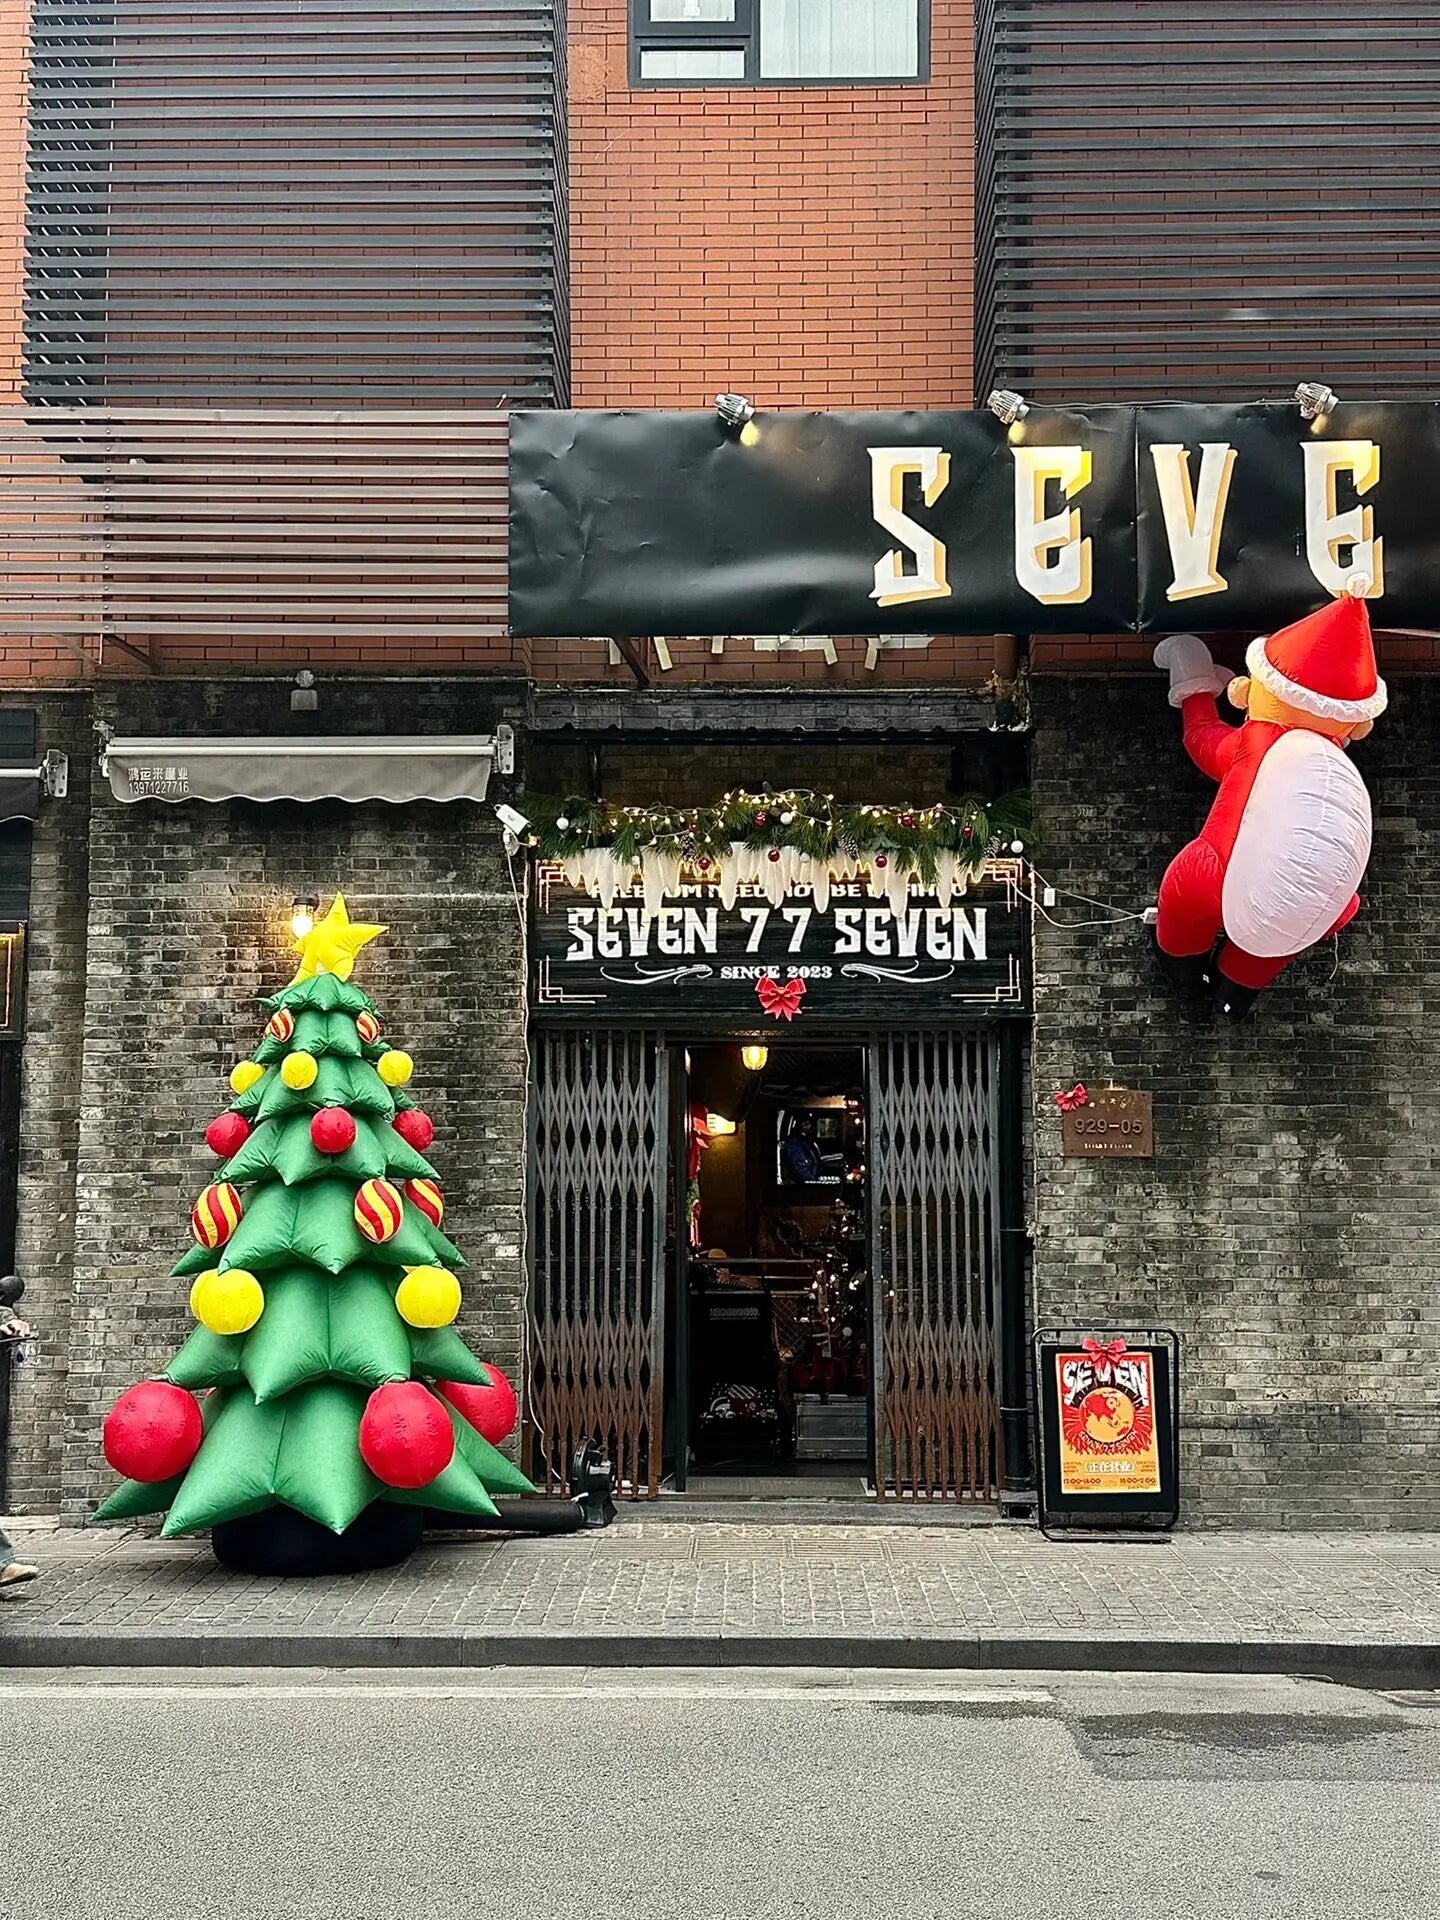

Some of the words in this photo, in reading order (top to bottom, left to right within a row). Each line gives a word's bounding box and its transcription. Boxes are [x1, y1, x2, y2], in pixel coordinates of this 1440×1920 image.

[128, 780, 190, 795] 13971227716
[830, 883, 862, 898] BE
[566, 907, 718, 961] SEVEN
[834, 907, 988, 961] SEVEN
[720, 965, 781, 980] SINCE
[786, 965, 833, 979] 2023
[1074, 1118, 1143, 1135] 929-05
